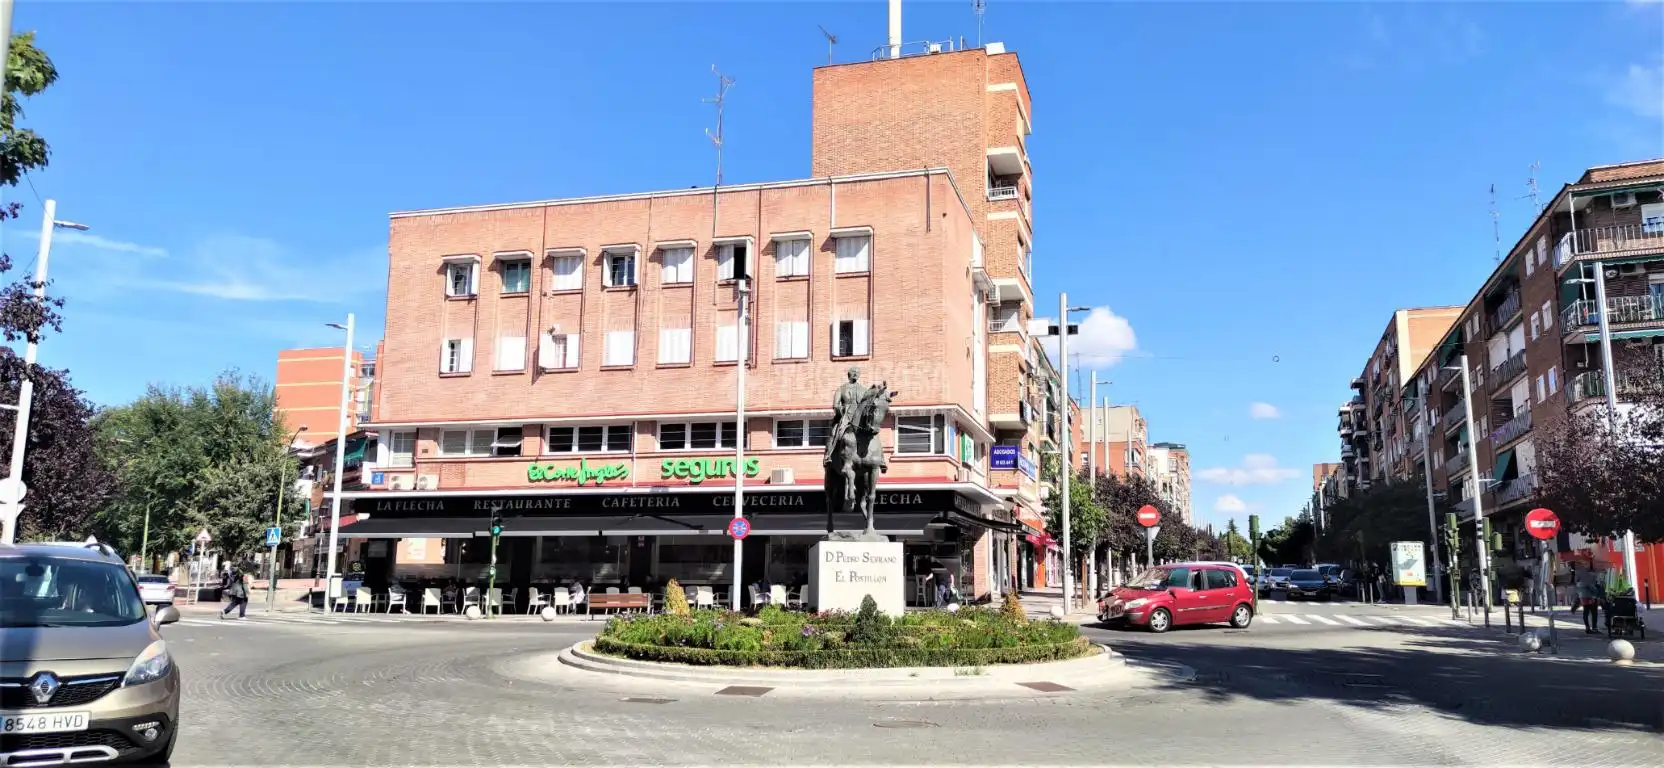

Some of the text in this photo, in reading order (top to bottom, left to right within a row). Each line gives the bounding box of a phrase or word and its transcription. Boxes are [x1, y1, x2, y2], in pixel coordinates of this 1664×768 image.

[474, 498, 572, 510] RESTAURANTE
[602, 496, 680, 508] CAFETERIA
[866, 493, 923, 505] LECHA
[377, 500, 445, 511] LA FLECHA
[4, 714, 84, 732] 8548 HVD
